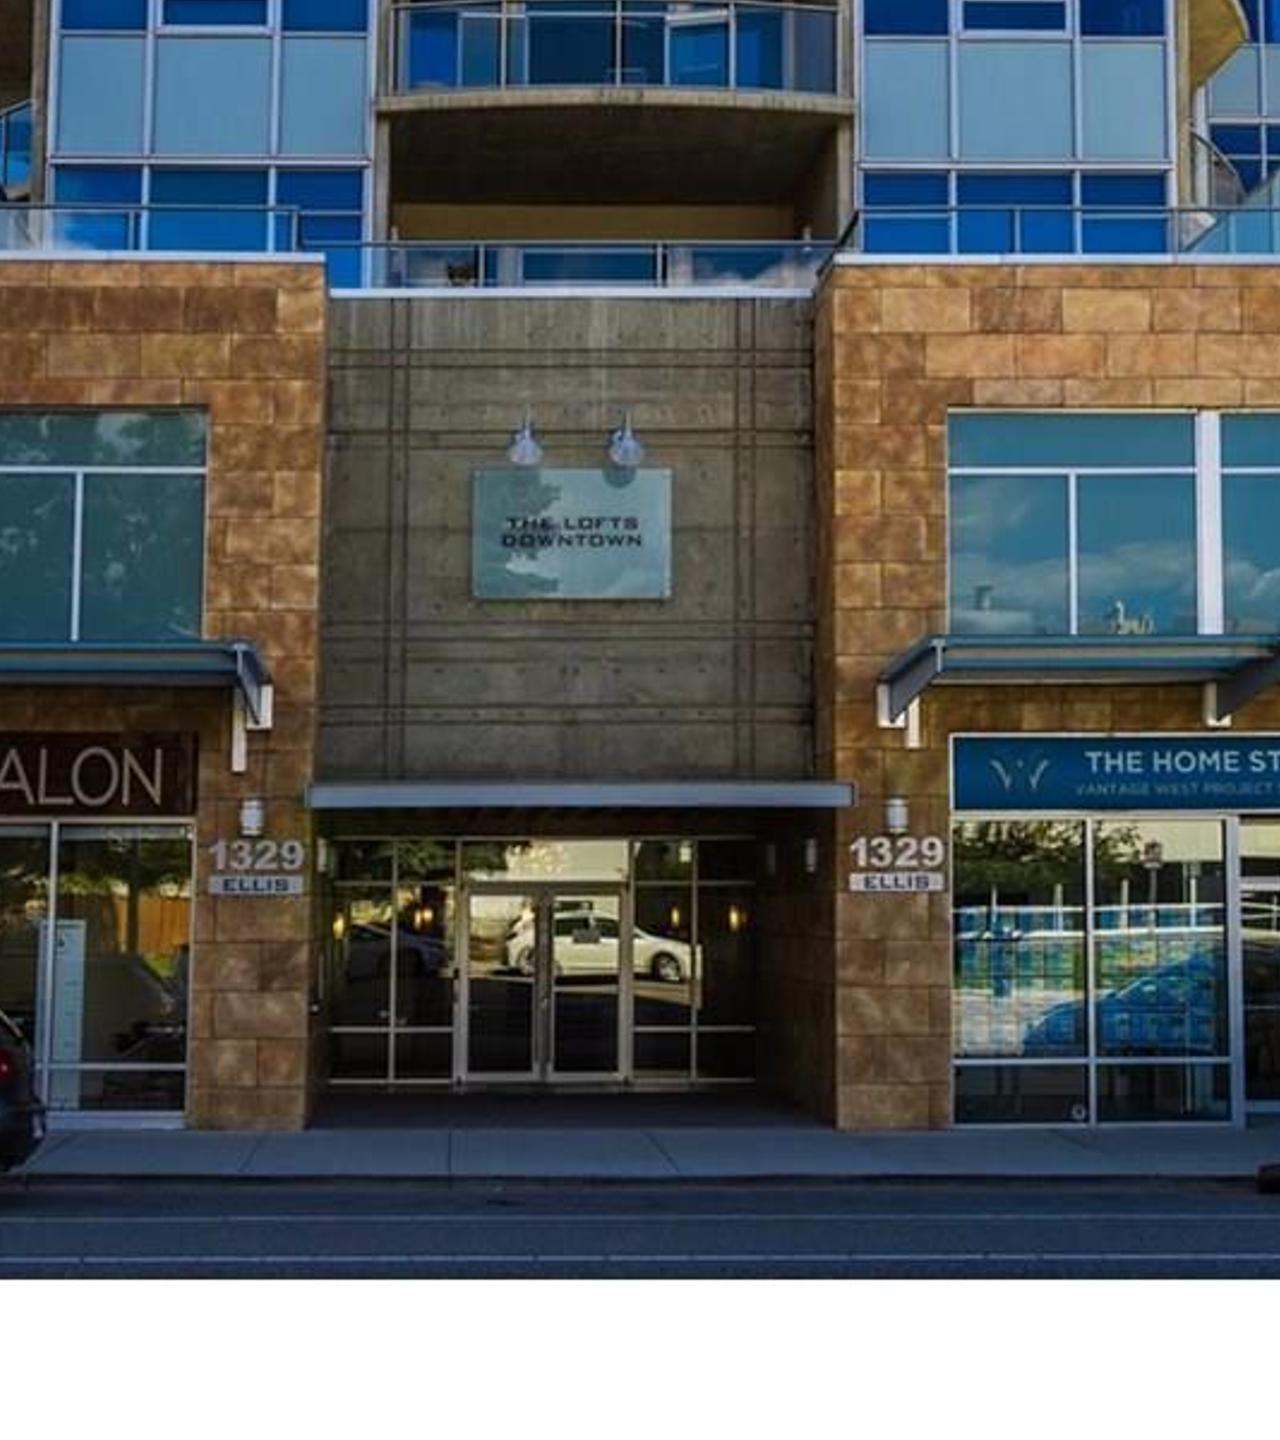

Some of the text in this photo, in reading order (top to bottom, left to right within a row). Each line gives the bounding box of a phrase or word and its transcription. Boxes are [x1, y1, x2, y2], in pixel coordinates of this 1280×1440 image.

[505, 516, 639, 531] THE LOFTS
[501, 533, 642, 549] DOWNTOWN
[1084, 750, 1143, 773] THE
[1153, 750, 1240, 773] HOME
[1076, 782, 1150, 796] VANTAGE
[1155, 782, 1199, 795] WEST
[208, 840, 304, 870] 1329
[850, 836, 944, 868] 1329
[223, 878, 289, 892] ELLIS
[864, 875, 929, 890] ELLIS
